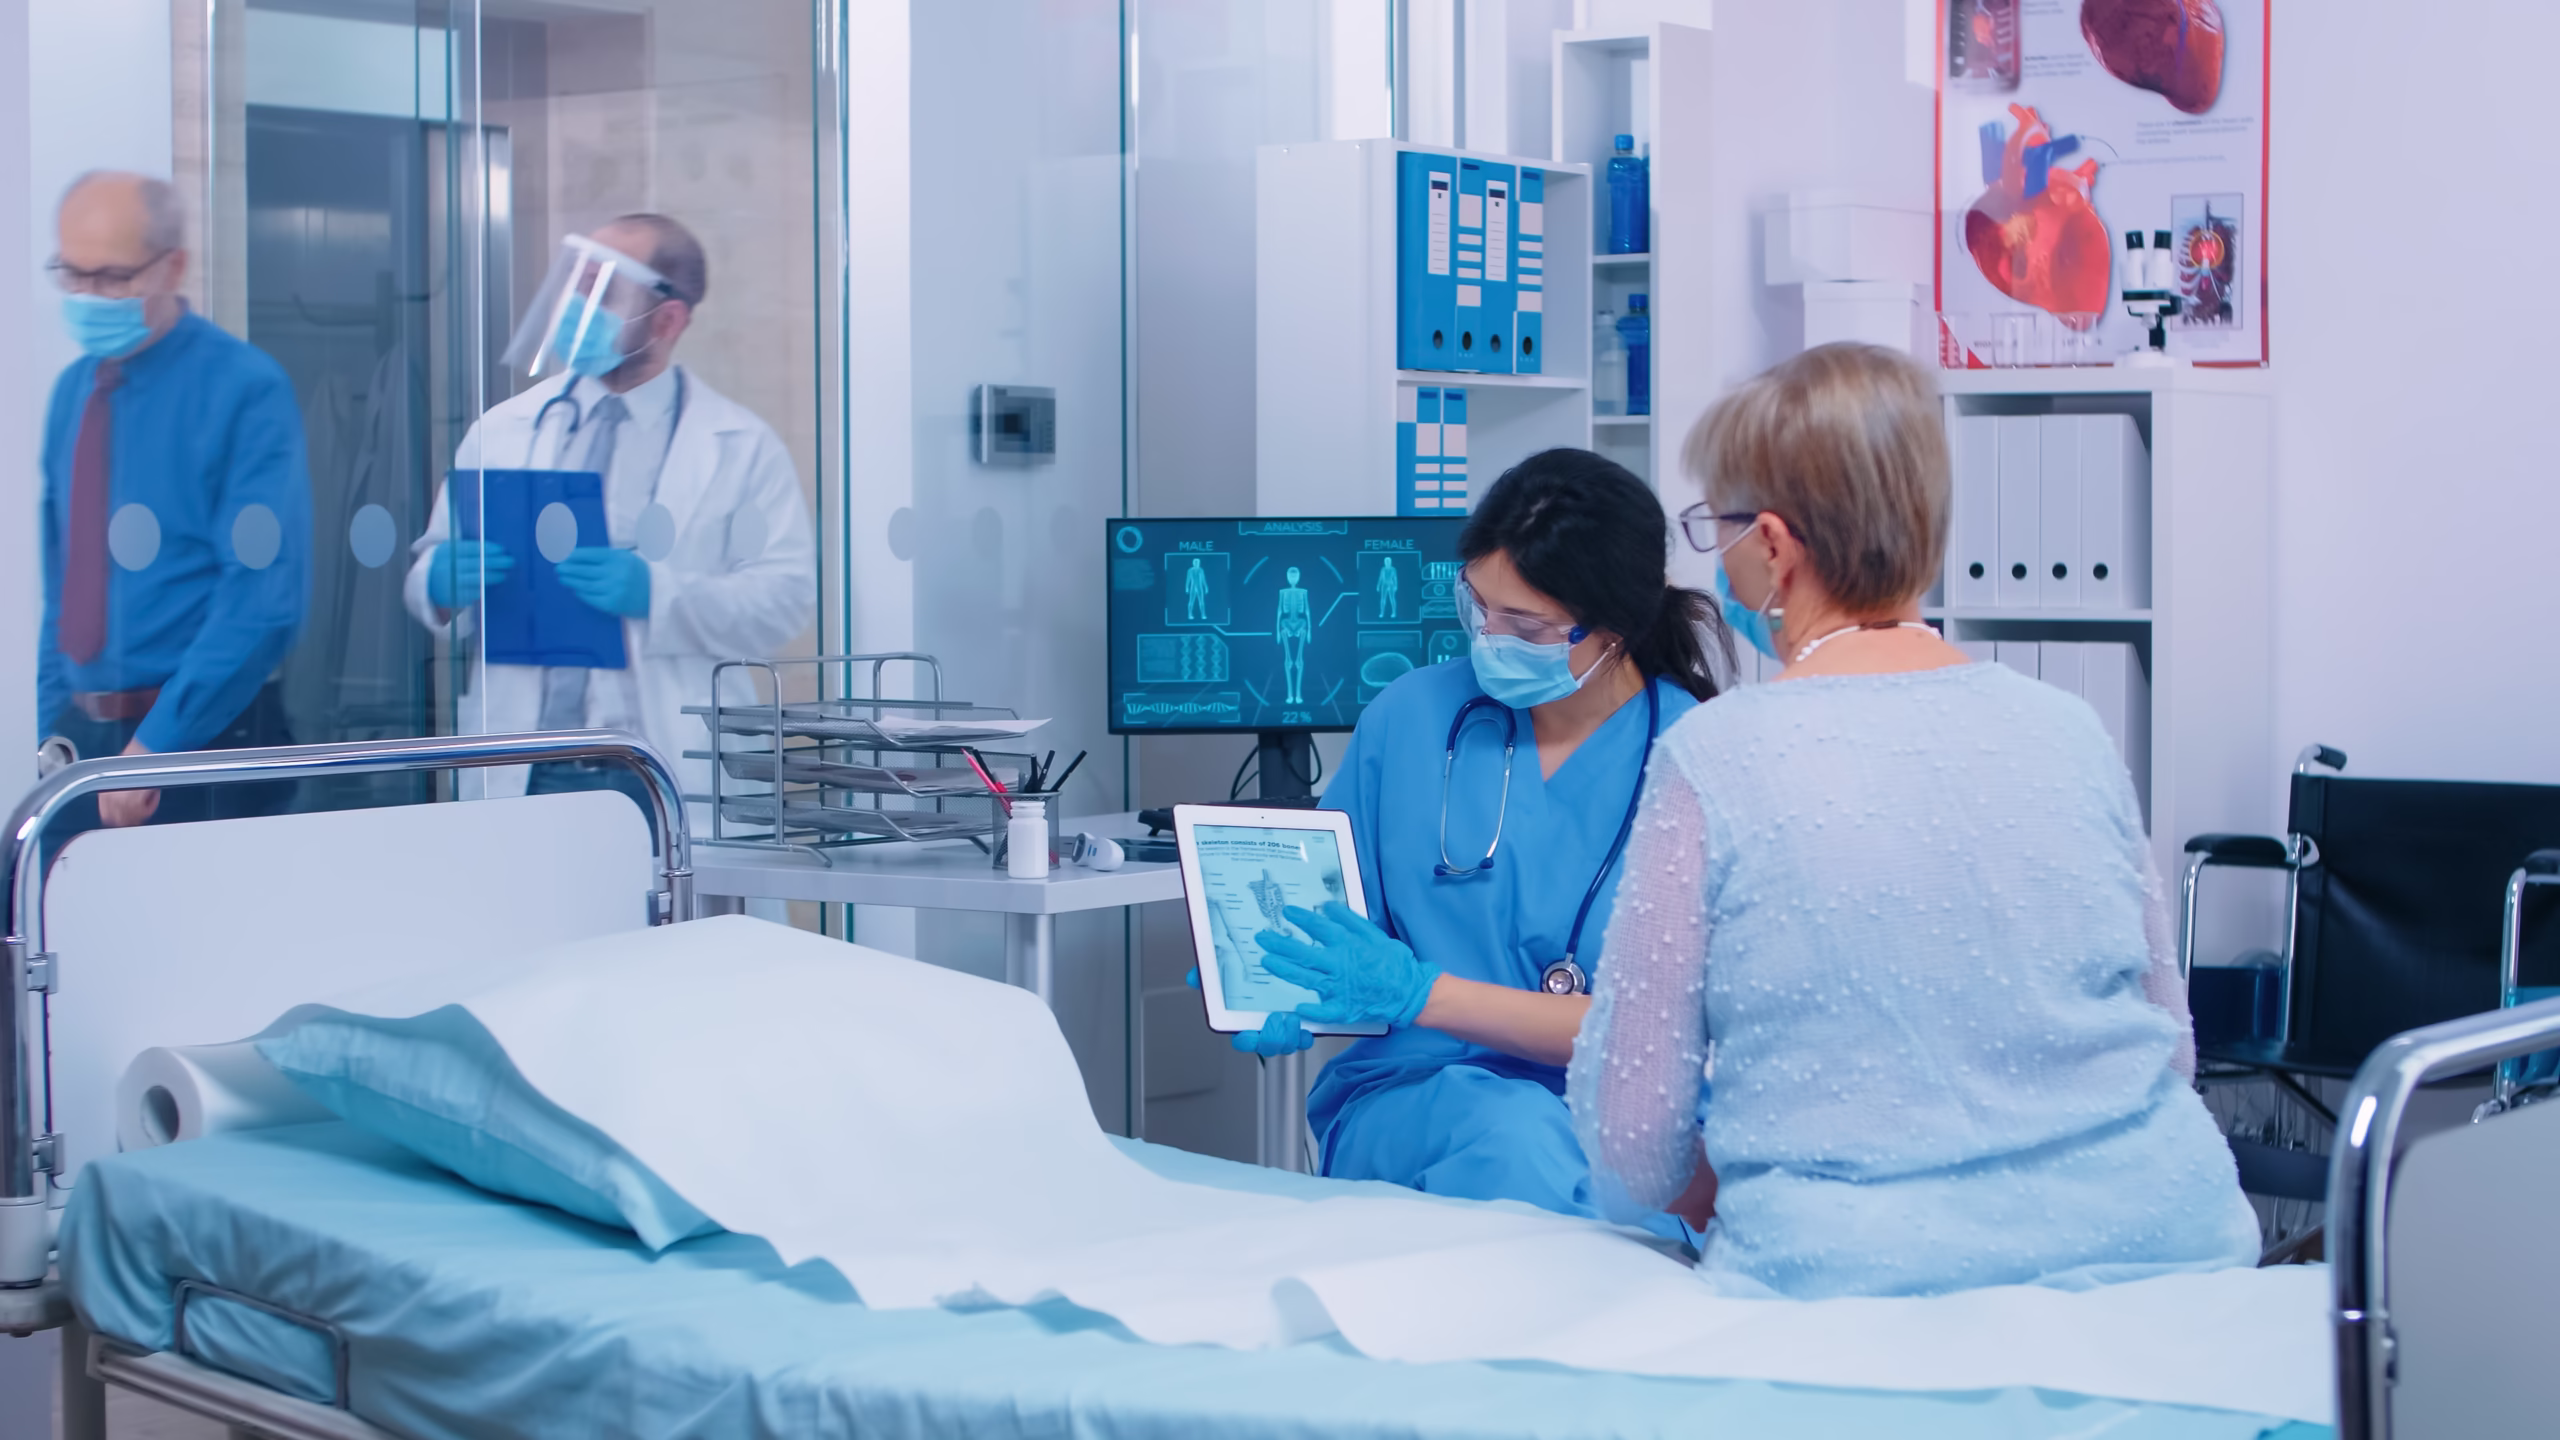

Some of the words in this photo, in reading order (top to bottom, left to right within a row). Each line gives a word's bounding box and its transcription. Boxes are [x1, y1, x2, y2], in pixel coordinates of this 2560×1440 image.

[1263, 521, 1323, 533] ANALYSIS
[1179, 540, 1214, 552] MALE
[1364, 539, 1414, 550] FEMALE
